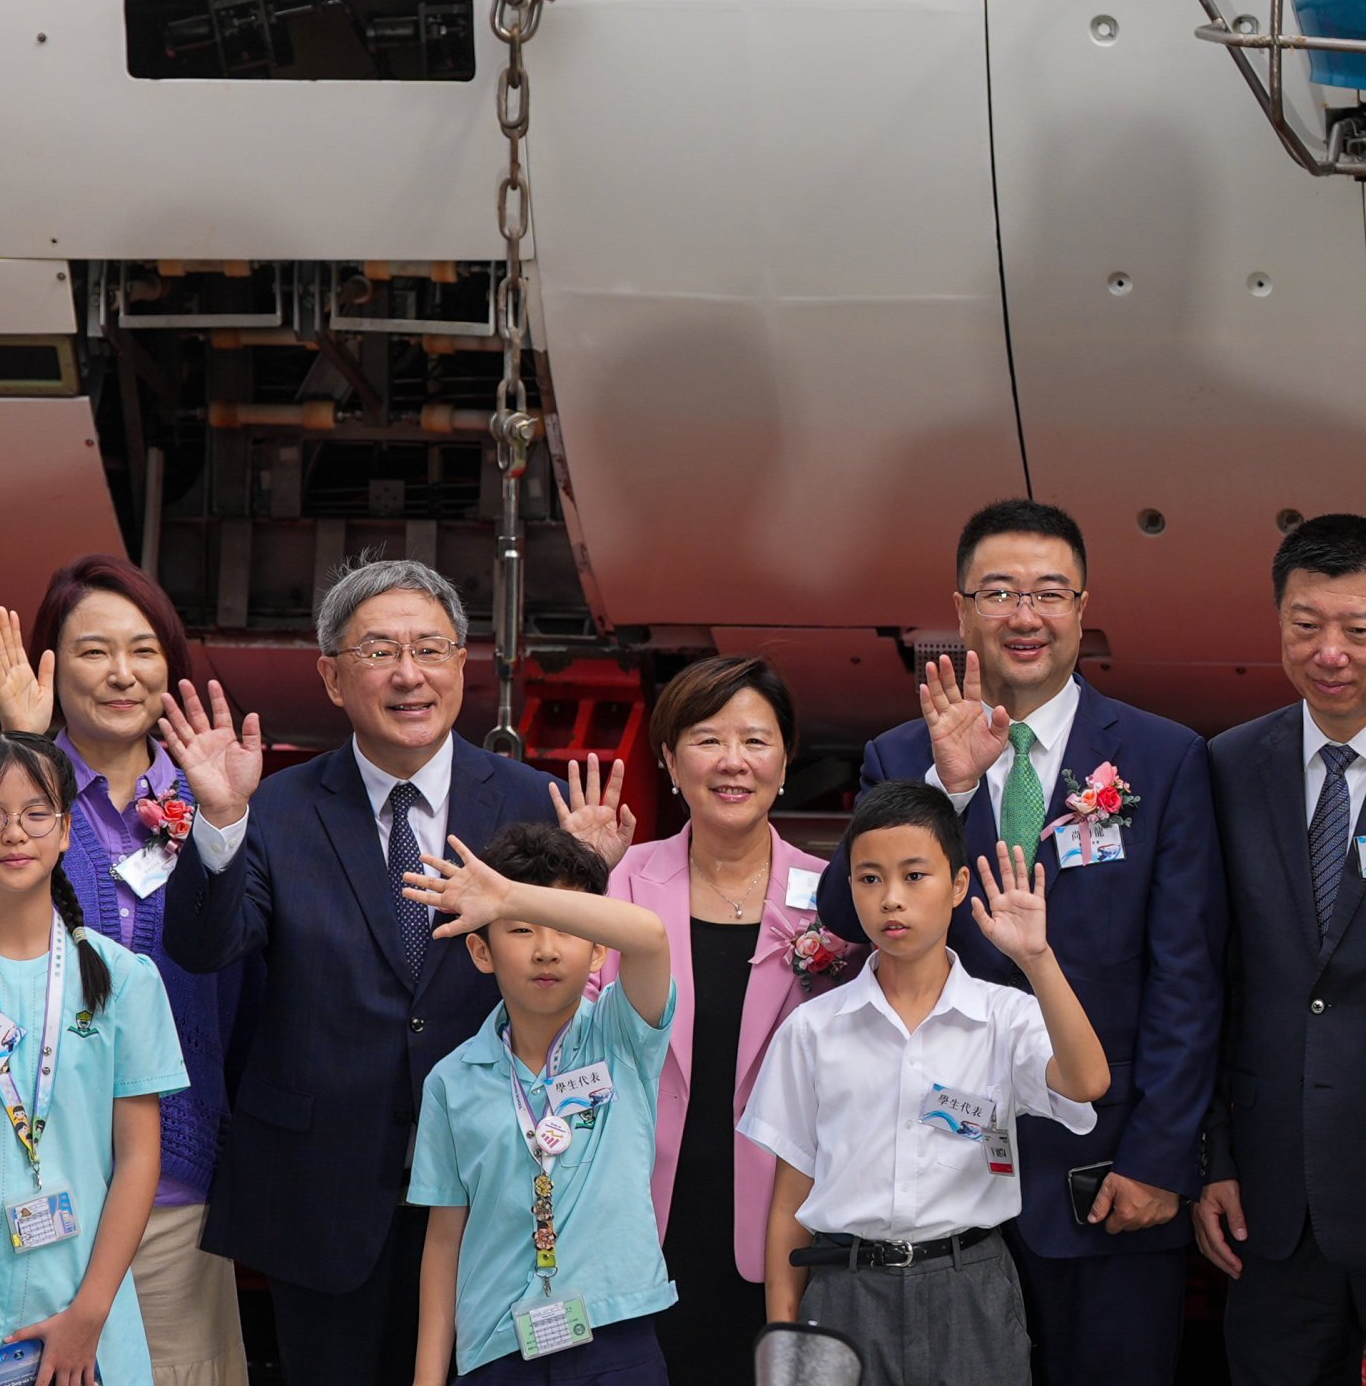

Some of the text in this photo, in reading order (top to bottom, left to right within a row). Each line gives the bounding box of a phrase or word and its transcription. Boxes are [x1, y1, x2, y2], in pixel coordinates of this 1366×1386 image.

[1072, 826, 1104, 841] 尚龍
[556, 1072, 600, 1093] 學生代表
[938, 1094, 982, 1118] 學生代表
